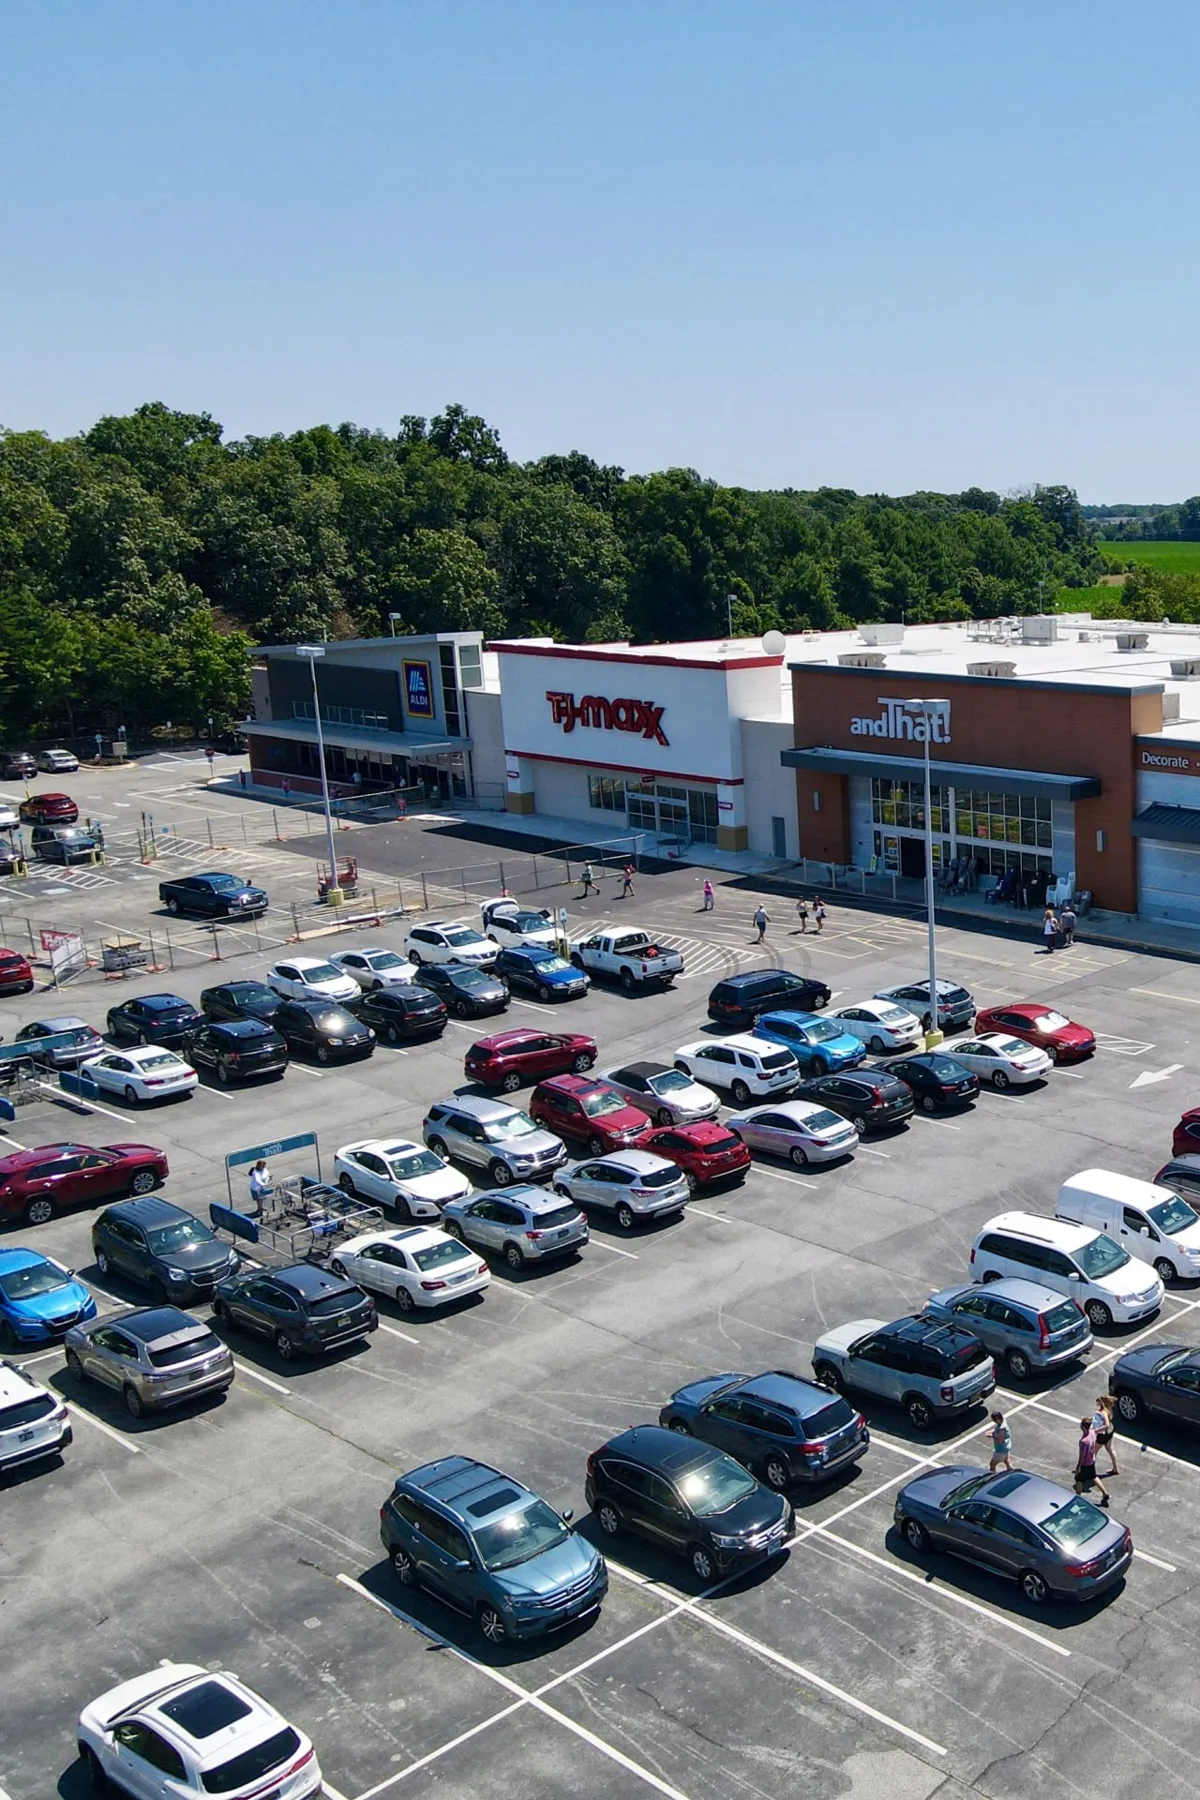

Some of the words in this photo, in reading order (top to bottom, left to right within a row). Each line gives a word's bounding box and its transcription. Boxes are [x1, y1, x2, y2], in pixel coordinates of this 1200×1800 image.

[410, 694, 428, 706] ALDI
[1141, 752, 1189, 769] Decorate
[968, 949, 1128, 999] FIRE
